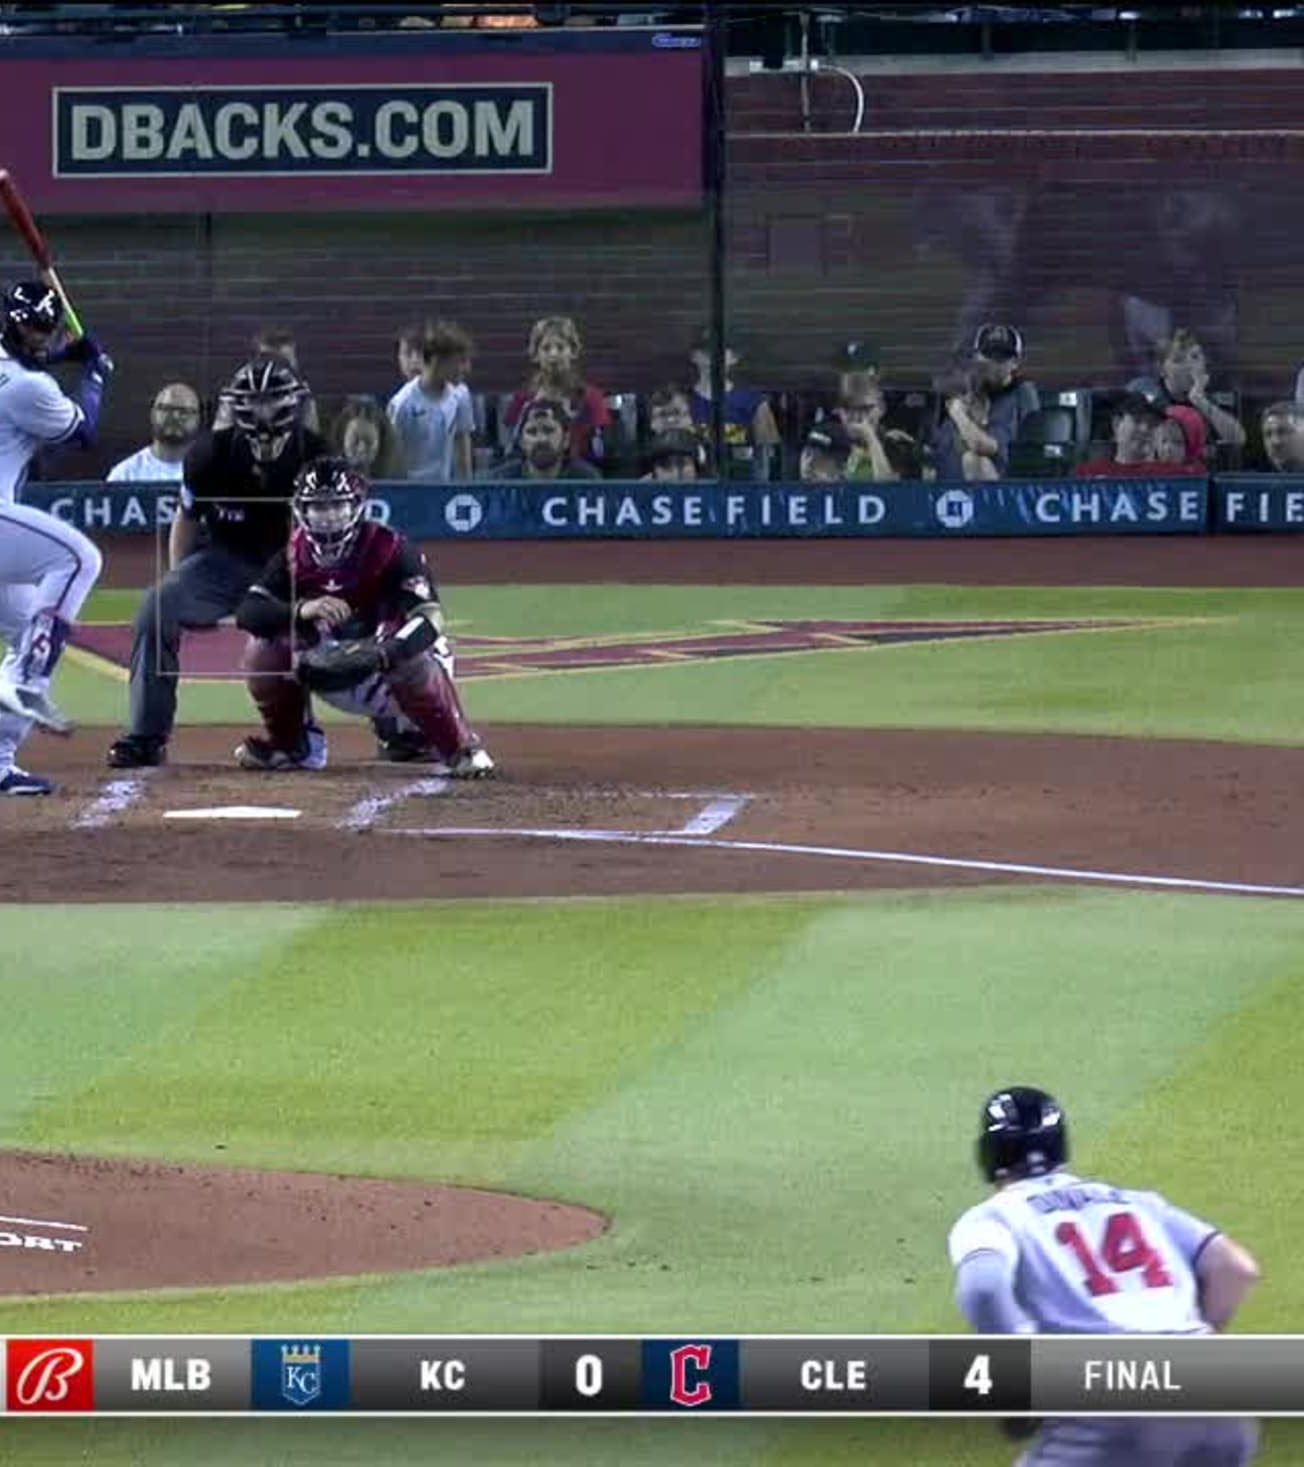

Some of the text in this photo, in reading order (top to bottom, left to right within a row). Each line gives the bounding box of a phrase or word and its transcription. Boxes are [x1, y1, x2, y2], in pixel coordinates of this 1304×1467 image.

[71, 99, 534, 161] DBACKS.COM
[50, 498, 179, 527] CHAS
[541, 494, 886, 527] CHASE FIELD
[1035, 490, 1199, 523] CHASE
[1053, 1211, 1174, 1297] 14
